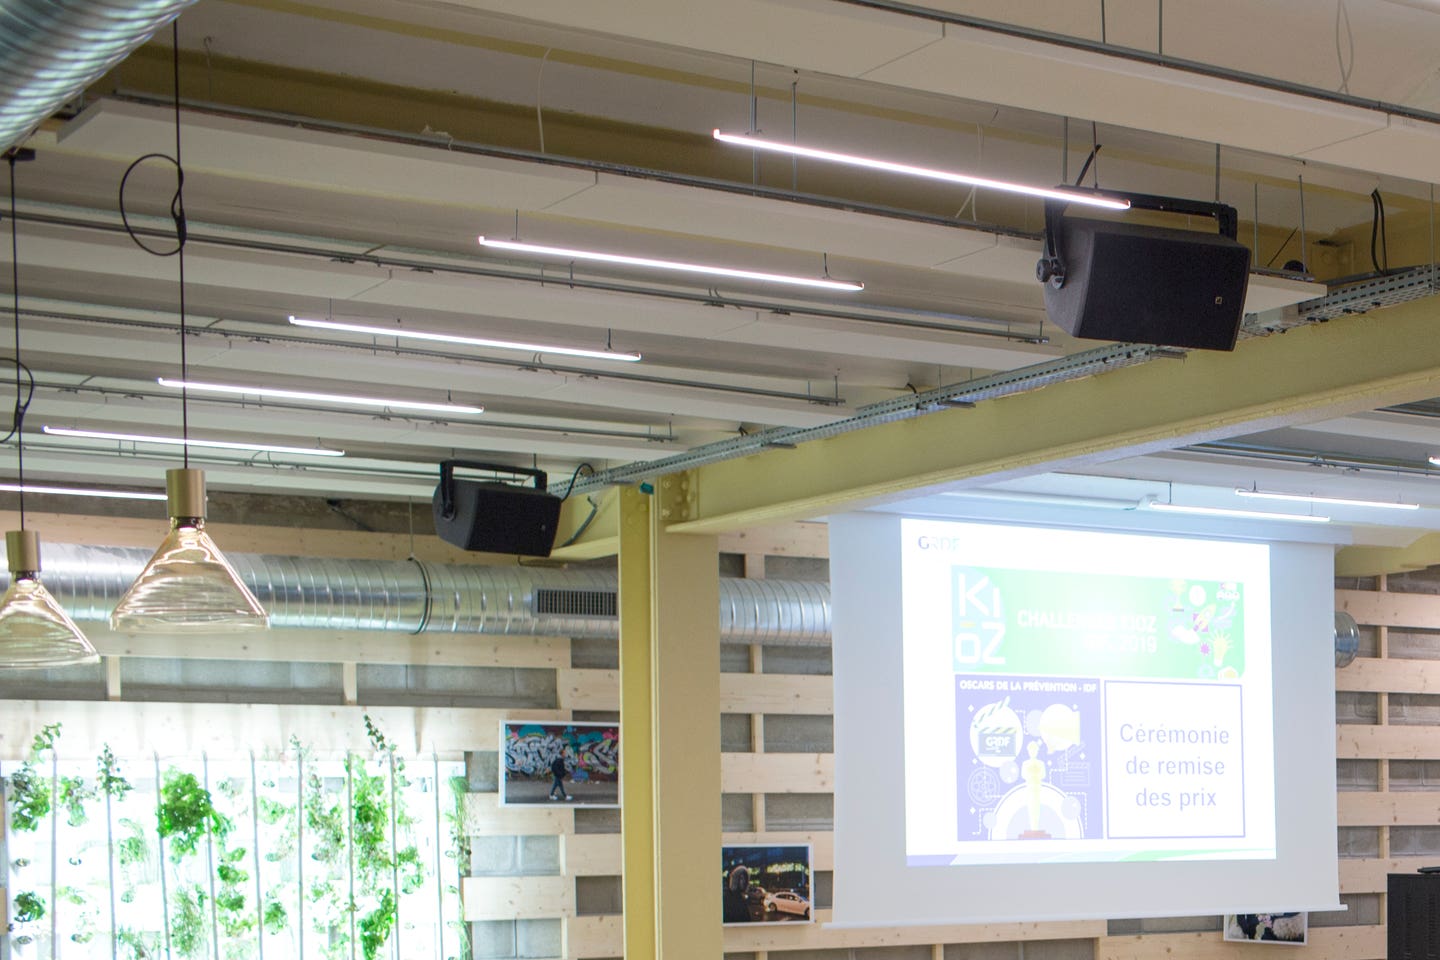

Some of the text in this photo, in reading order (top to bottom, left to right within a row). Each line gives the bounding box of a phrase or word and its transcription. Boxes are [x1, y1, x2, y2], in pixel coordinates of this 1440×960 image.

[959, 680, 995, 690] OSCARS
[996, 681, 1009, 690] DE
[1010, 681, 1022, 691] LA
[1023, 680, 1078, 692] PRÉVENTION
[1083, 683, 1097, 693] IDF
[1119, 723, 1230, 744] Cérémonie
[1126, 755, 1225, 775] de remise
[1135, 787, 1217, 811] des prix
